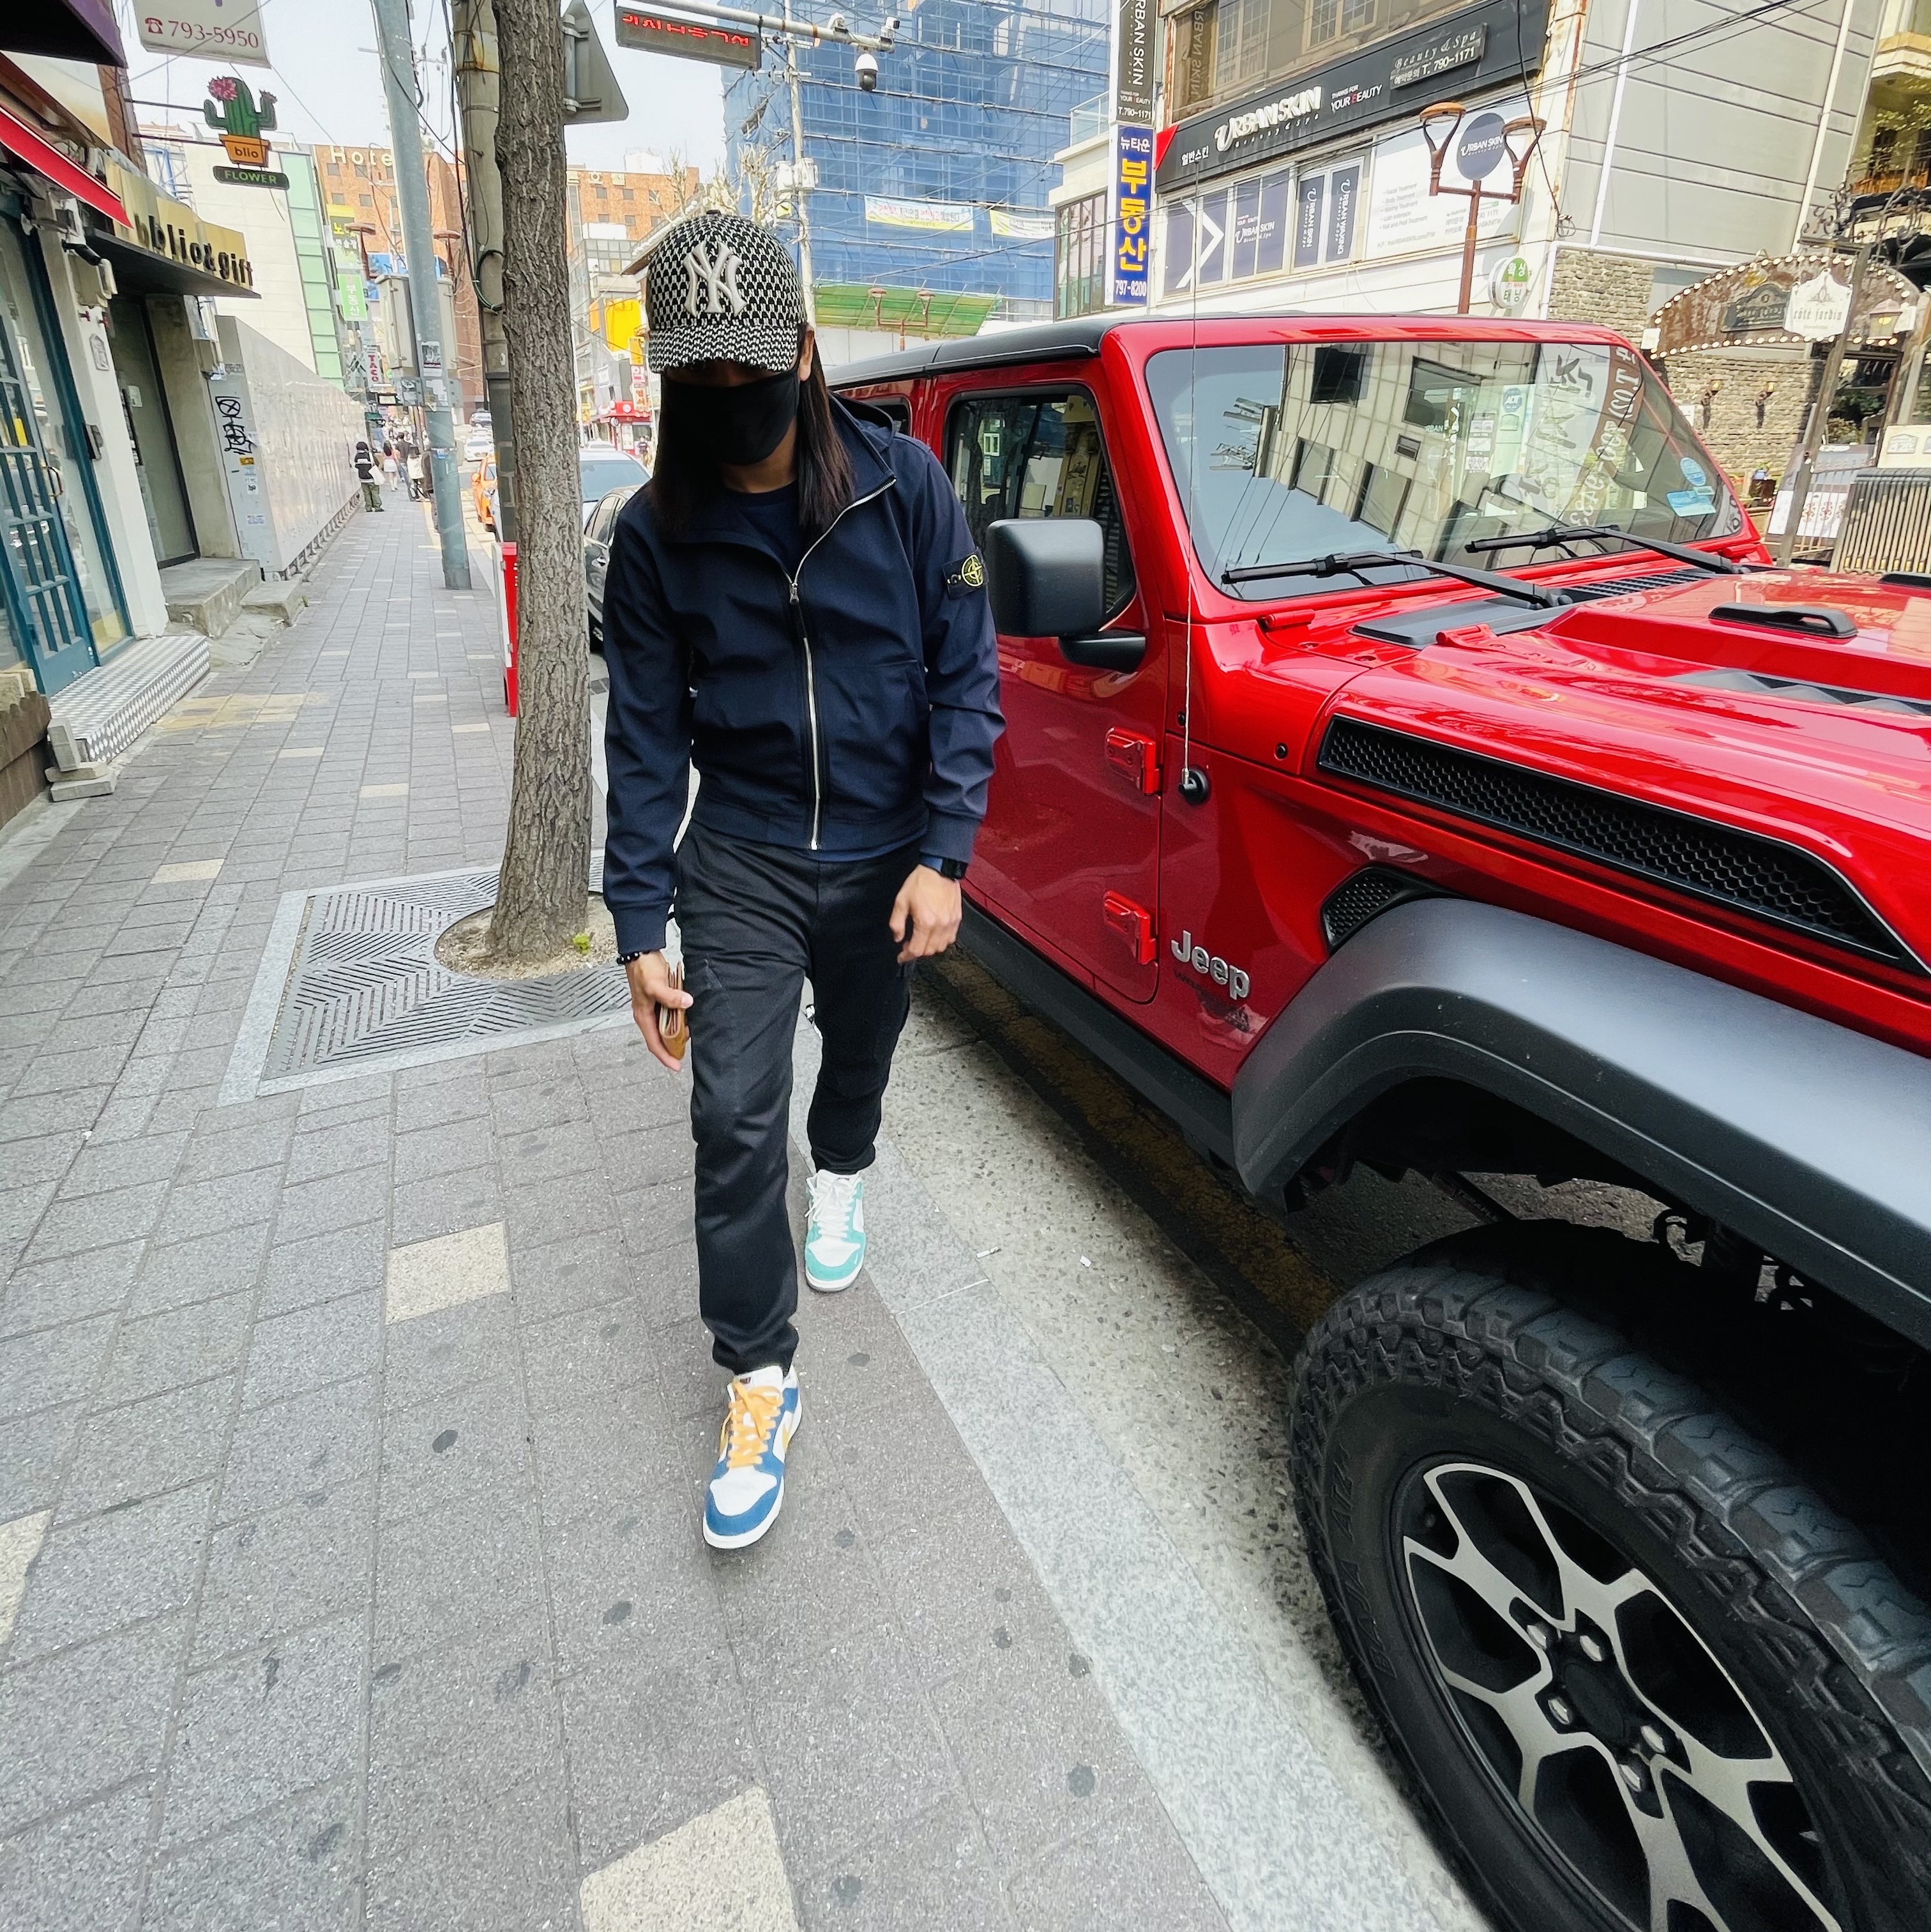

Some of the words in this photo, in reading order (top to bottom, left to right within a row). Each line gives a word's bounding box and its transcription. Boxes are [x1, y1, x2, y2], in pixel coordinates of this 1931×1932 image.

[167, 20, 259, 49] 793-5950
[1135, 0, 1146, 45] RBAN
[1395, 47, 1437, 69] Beauty
[1441, 38, 1452, 52] &
[1453, 30, 1477, 49] Spa
[1433, 46, 1476, 72] 790-1171
[1132, 47, 1144, 86] SKIN
[1214, 103, 1278, 152] URBAN
[1278, 86, 1322, 123] SKIN
[1331, 96, 1351, 114] YOUR
[329, 145, 393, 167] Hote
[1120, 136, 1151, 153] 뉴타운
[1460, 139, 1488, 157] URBAN
[224, 170, 278, 185] FLOWER
[1119, 158, 1147, 271] 부동산
[1306, 187, 1317, 229] URBAN
[1340, 178, 1351, 221] URBAN
[346, 284, 361, 317] 부동산
[1115, 279, 1147, 297] 797-8200
[368, 354, 379, 382] TACO
[1171, 929, 1250, 1000] Jeep
